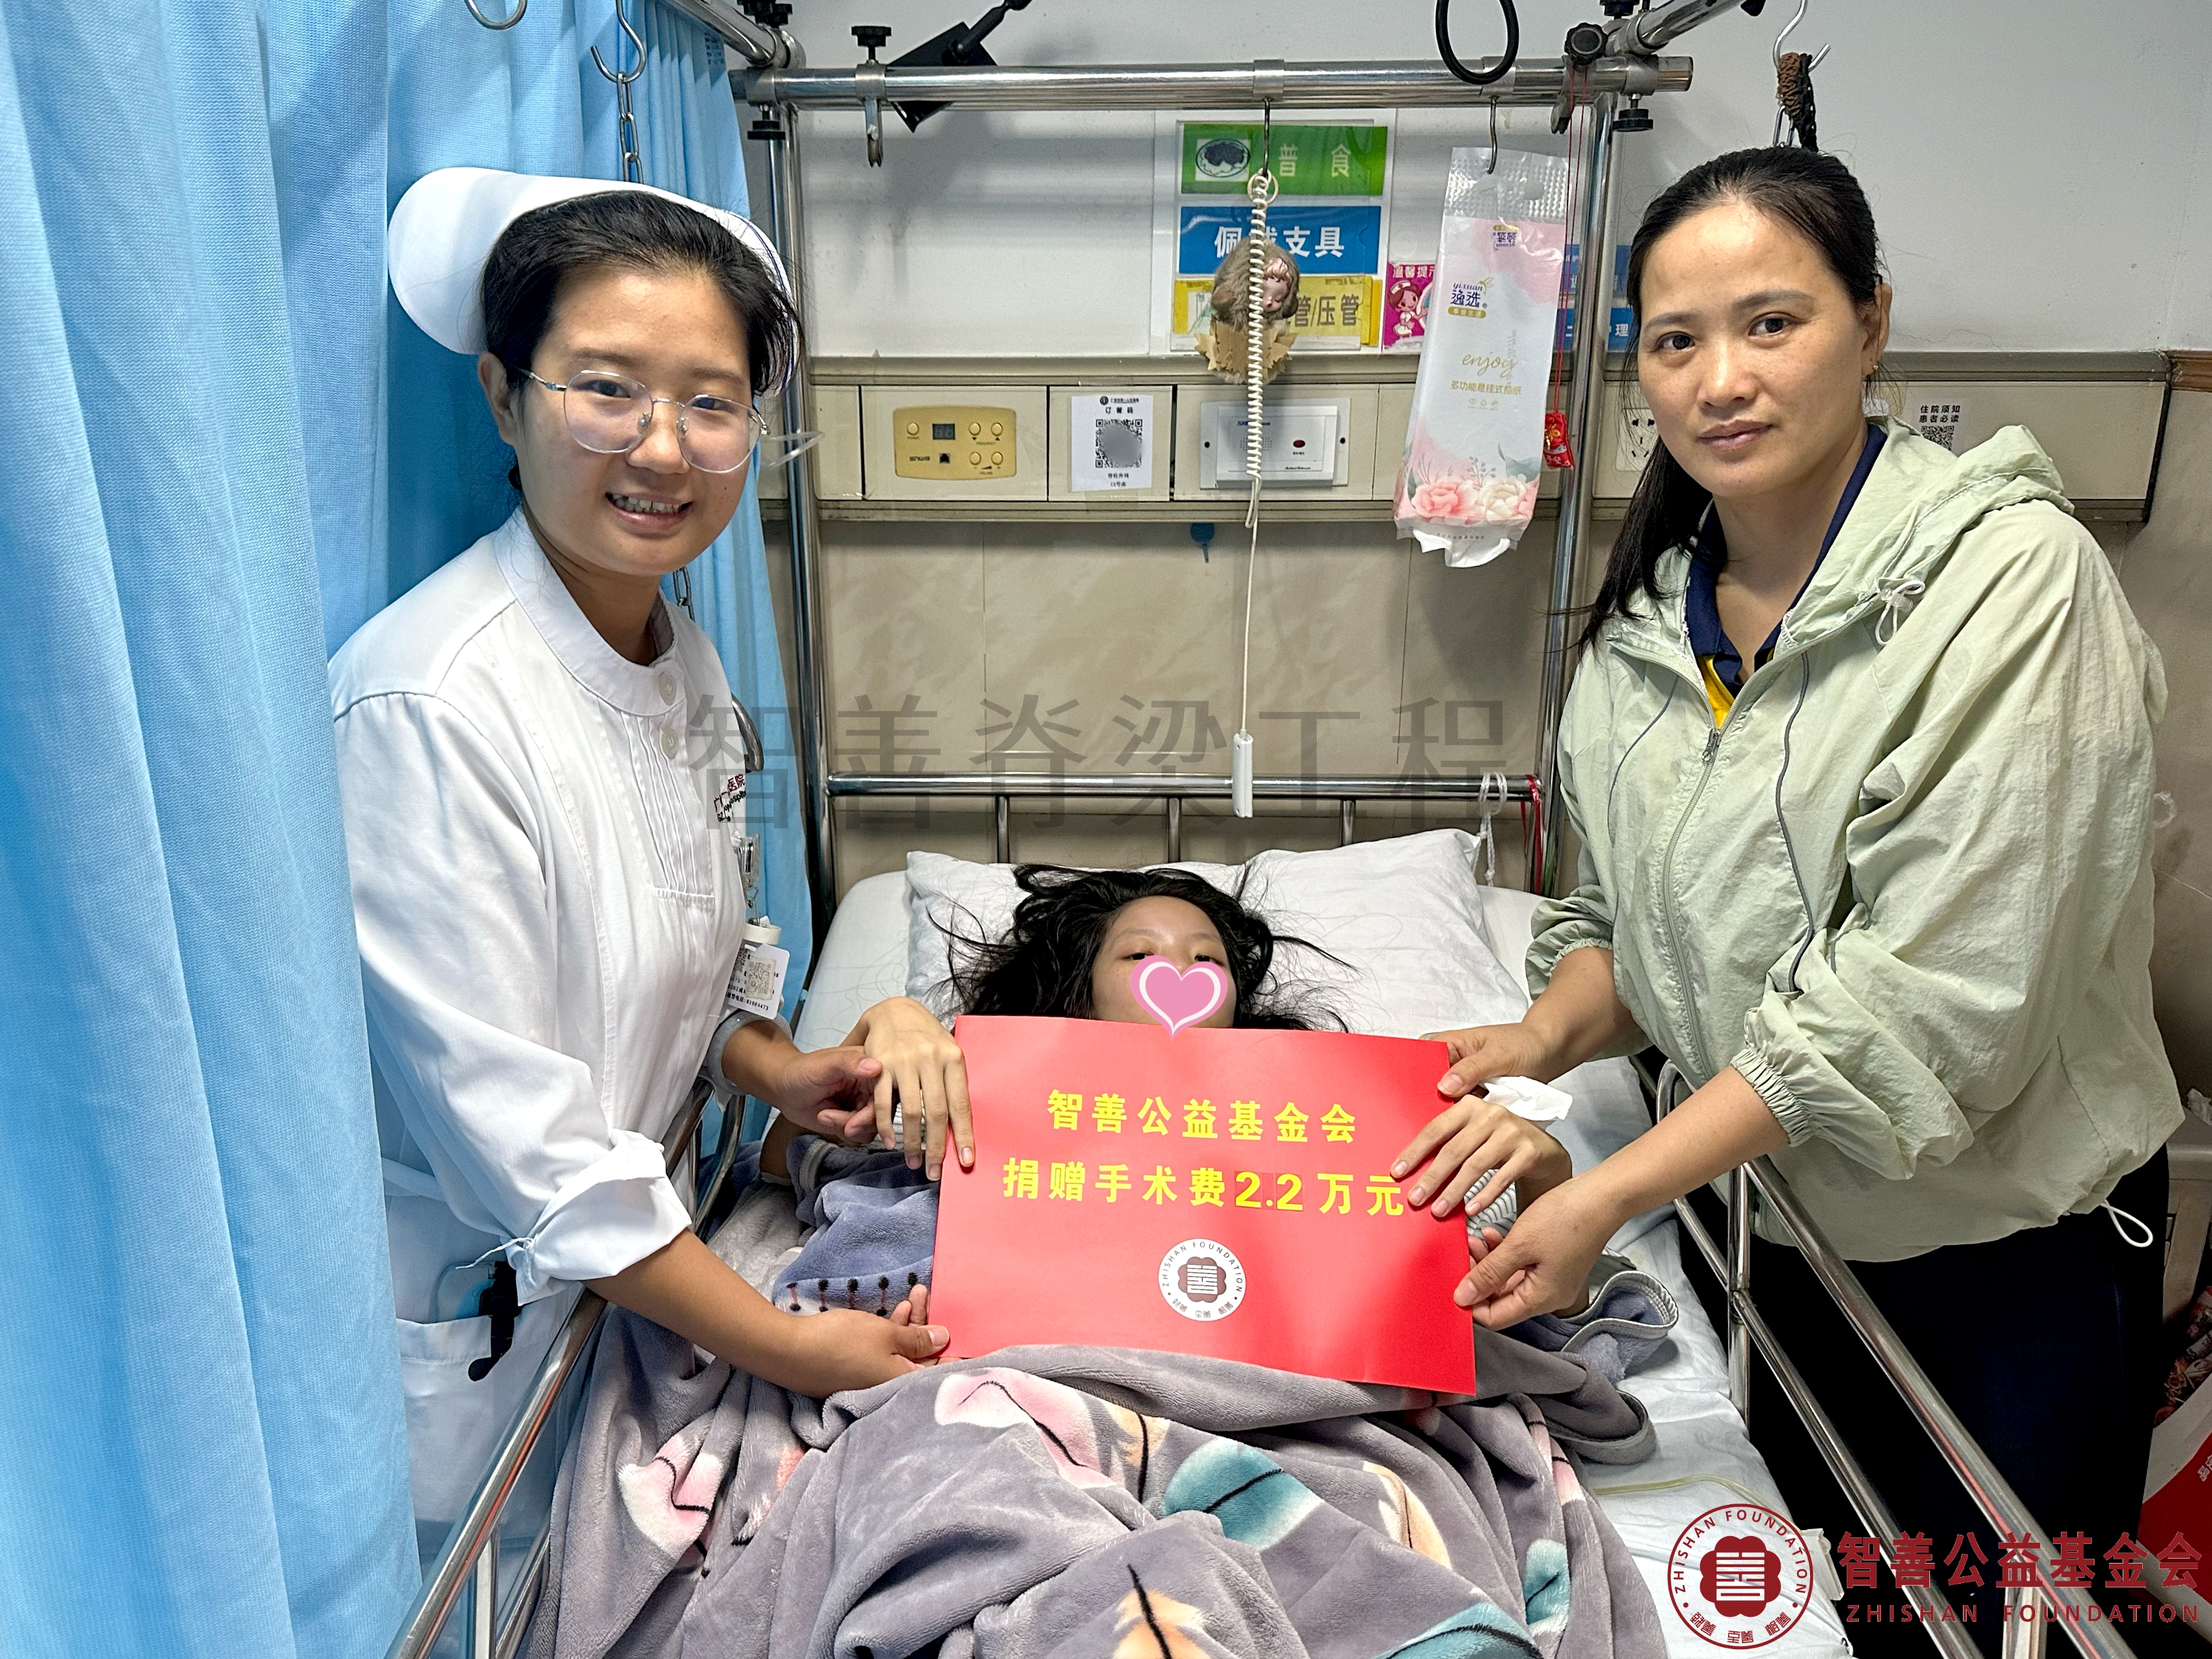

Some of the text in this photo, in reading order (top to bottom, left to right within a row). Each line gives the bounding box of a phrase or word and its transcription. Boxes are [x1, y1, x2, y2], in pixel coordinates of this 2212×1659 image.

[1279, 143, 1352, 178] 普食
[1919, 414, 1959, 423] 患者必读
[1920, 404, 1961, 414] 住院须知
[1048, 1090, 1355, 1144] 智善公益基金会
[1003, 1158, 1404, 1217] 捐赠手术费2.2万元
[1162, 1241, 1243, 1292] ZHISHAN FOUNDATION
